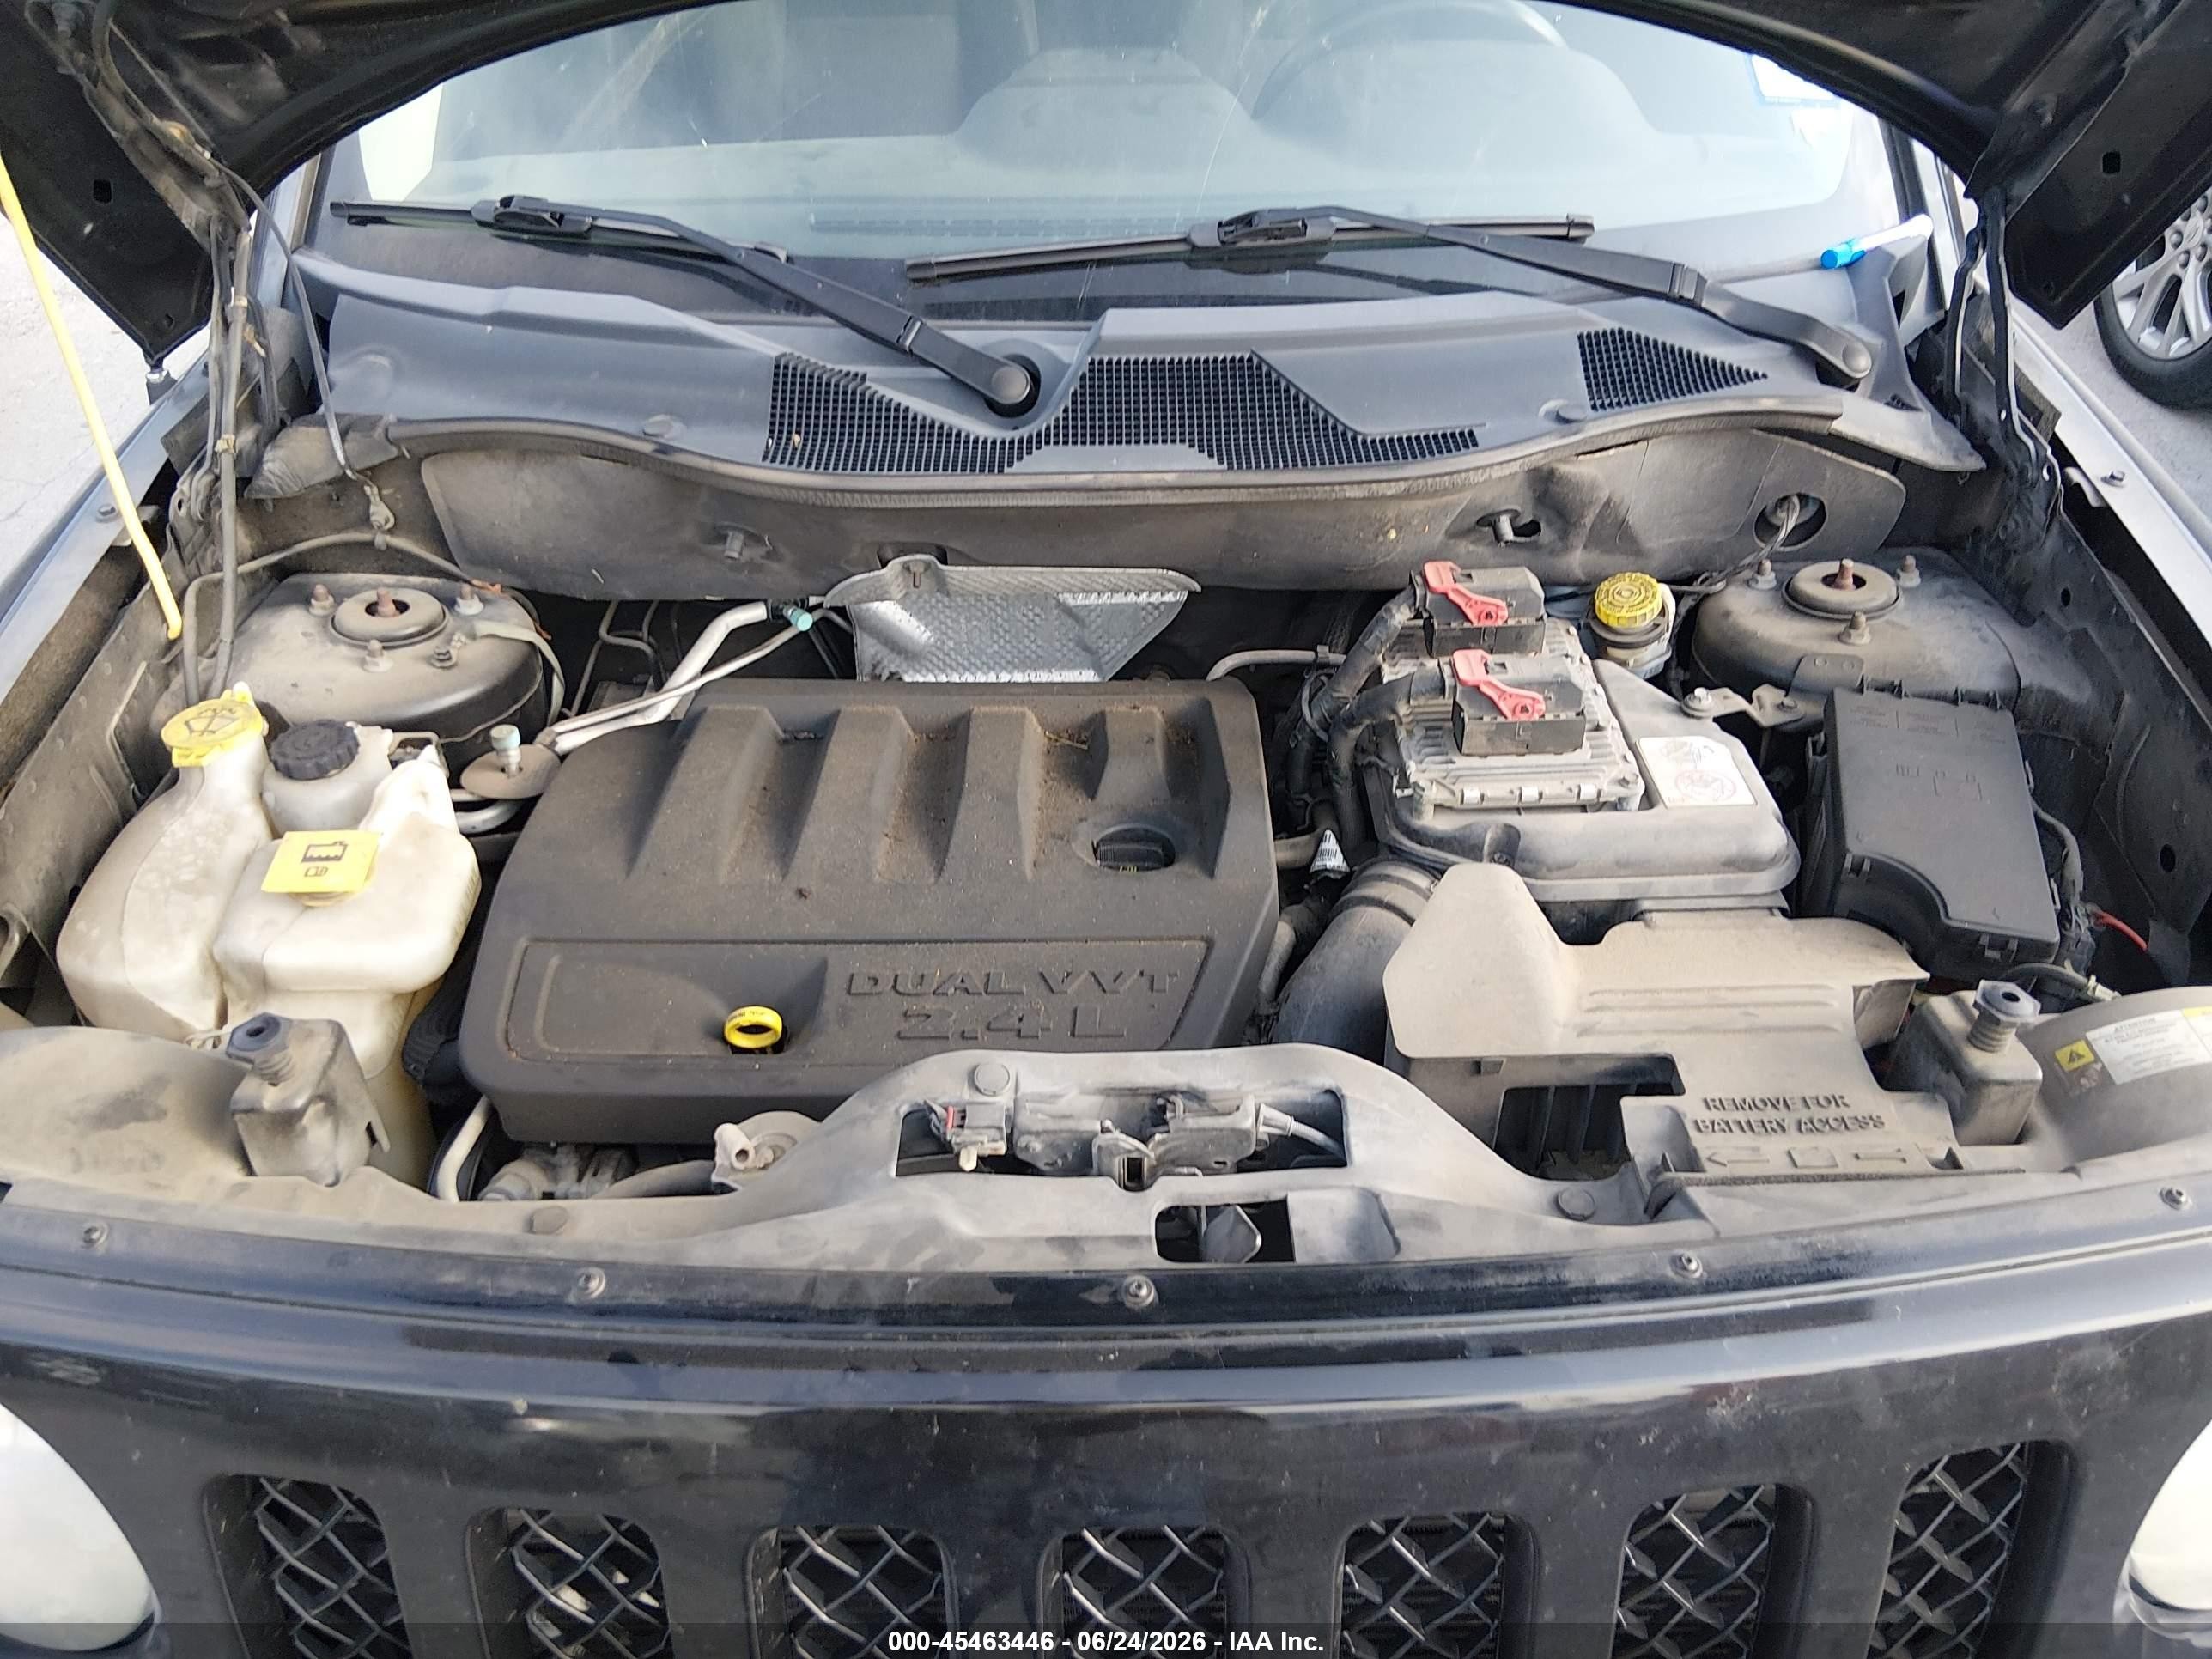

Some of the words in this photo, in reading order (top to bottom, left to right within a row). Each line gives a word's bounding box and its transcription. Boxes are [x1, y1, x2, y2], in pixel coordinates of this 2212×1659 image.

[847, 969, 1027, 996] DUAL
[1039, 968, 1180, 994] VVT
[1702, 1096, 1796, 1112] REMOVE
[1801, 1094, 1850, 1110] FOR
[1694, 1117, 1789, 1134] BATTERY
[1796, 1115, 1886, 1133] ACCESS
